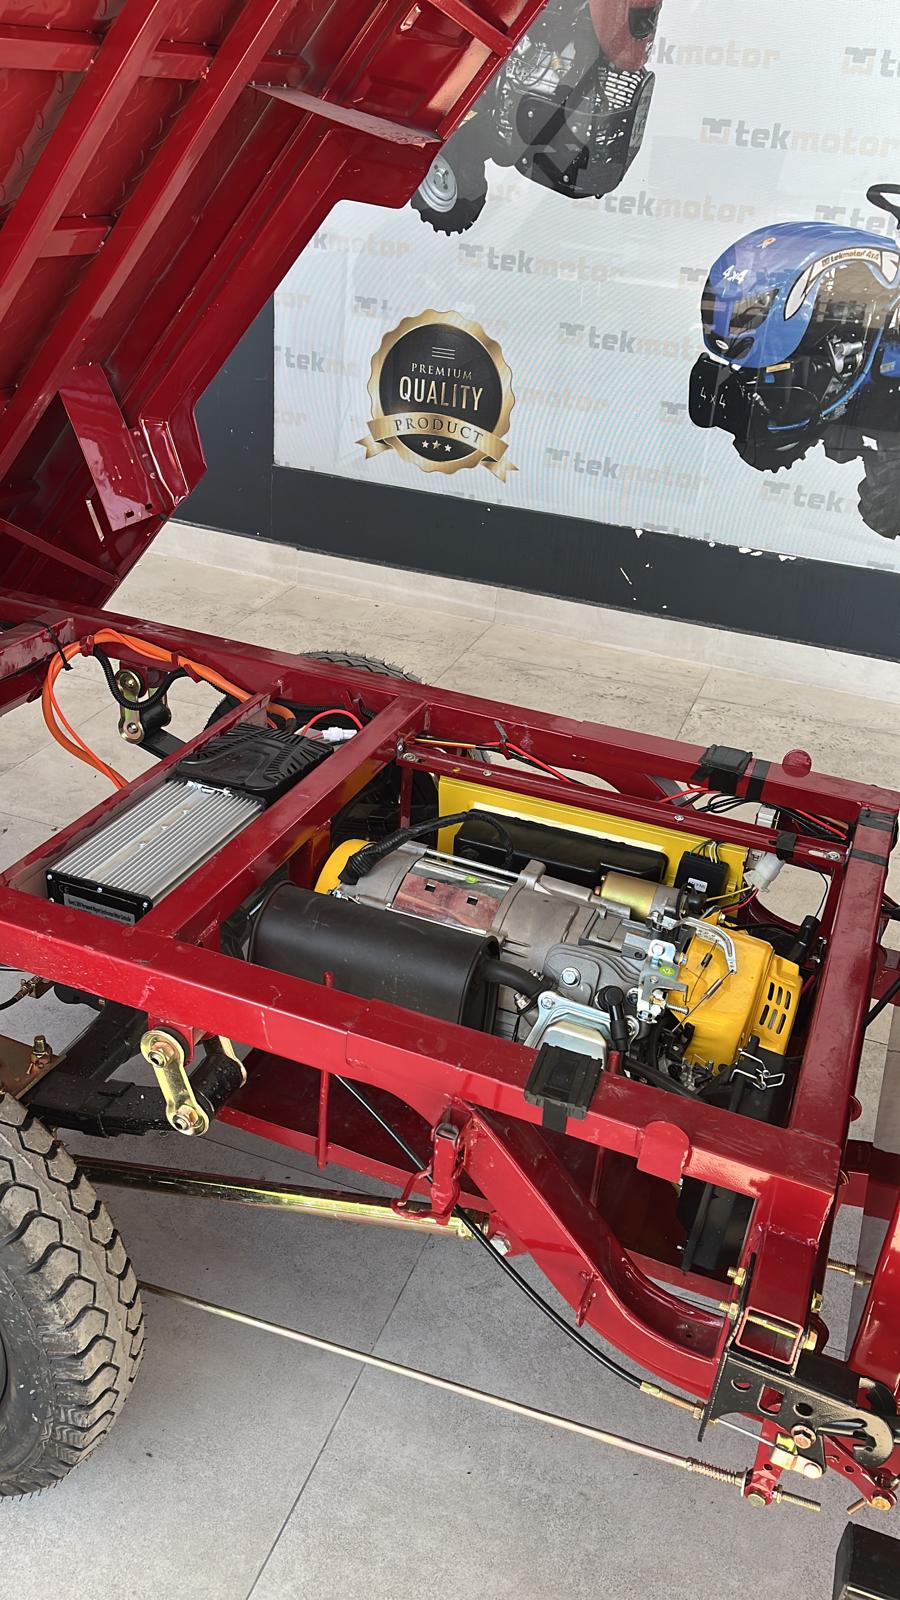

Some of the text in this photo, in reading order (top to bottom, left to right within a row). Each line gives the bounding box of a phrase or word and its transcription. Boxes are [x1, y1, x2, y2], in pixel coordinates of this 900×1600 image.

[650, 37, 781, 69] kmotor
[735, 119, 900, 157] tekmotor
[604, 191, 754, 223] tekmotor
[313, 232, 410, 258] kmotor
[487, 247, 625, 283] tekmotor
[722, 265, 749, 284] 4x4
[588, 325, 699, 361] tekmot
[411, 362, 472, 381] PREMIUM
[399, 376, 484, 411] QUALITY
[394, 417, 484, 444] PRODUCT
